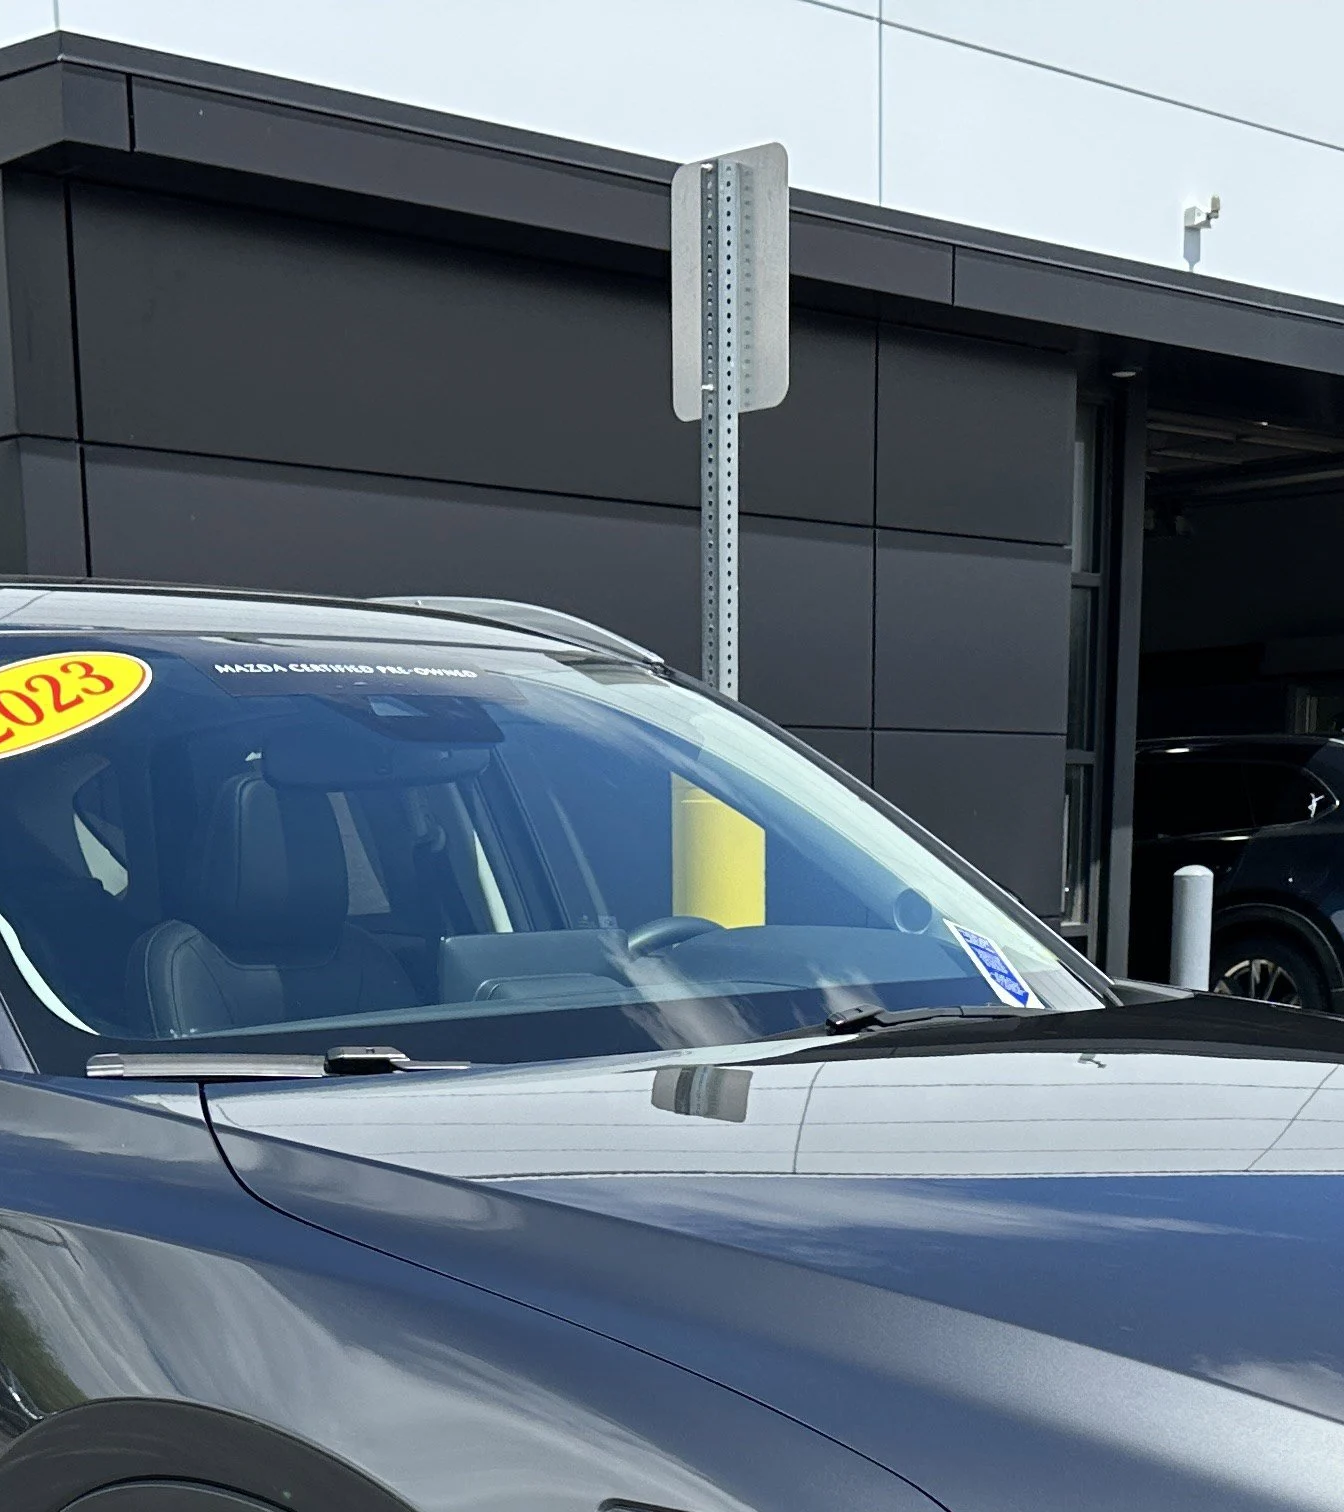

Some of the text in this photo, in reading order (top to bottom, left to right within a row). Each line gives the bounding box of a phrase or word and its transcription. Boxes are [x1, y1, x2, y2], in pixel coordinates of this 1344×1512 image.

[214, 663, 479, 679] MAZDA CERTIFIED PRE-OWNED
